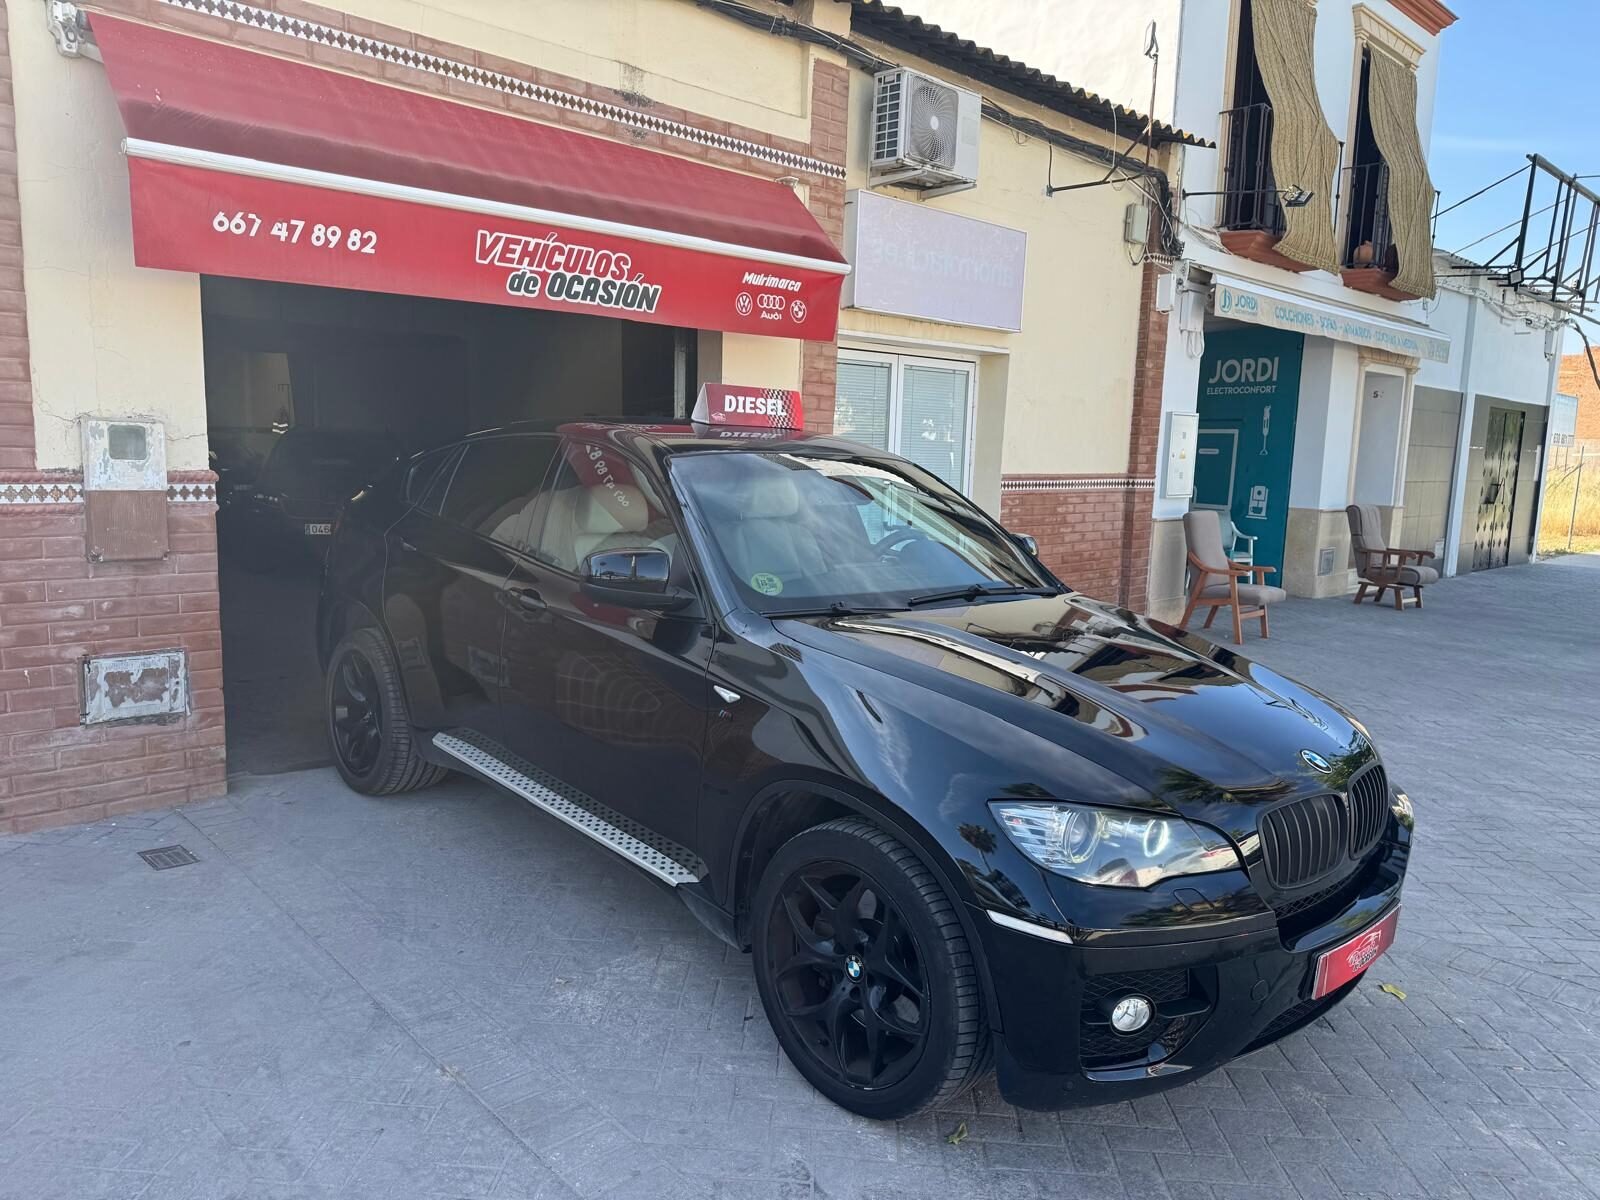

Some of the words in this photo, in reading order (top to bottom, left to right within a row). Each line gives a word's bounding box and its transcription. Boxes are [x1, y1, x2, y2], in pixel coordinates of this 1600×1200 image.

[212, 211, 262, 237] 667
[270, 219, 305, 244] 47
[311, 223, 342, 249] 89
[347, 228, 377, 254] 82
[476, 230, 631, 283] VEHÍCULOS
[507, 271, 541, 298] de
[545, 273, 662, 313] OCASIÓN
[1234, 294, 1258, 311] JORDI
[760, 310, 782, 320] Audi
[1208, 356, 1279, 384] JORDI
[1206, 385, 1277, 396] ELECTROCONFORT
[724, 394, 787, 417] DIESEL
